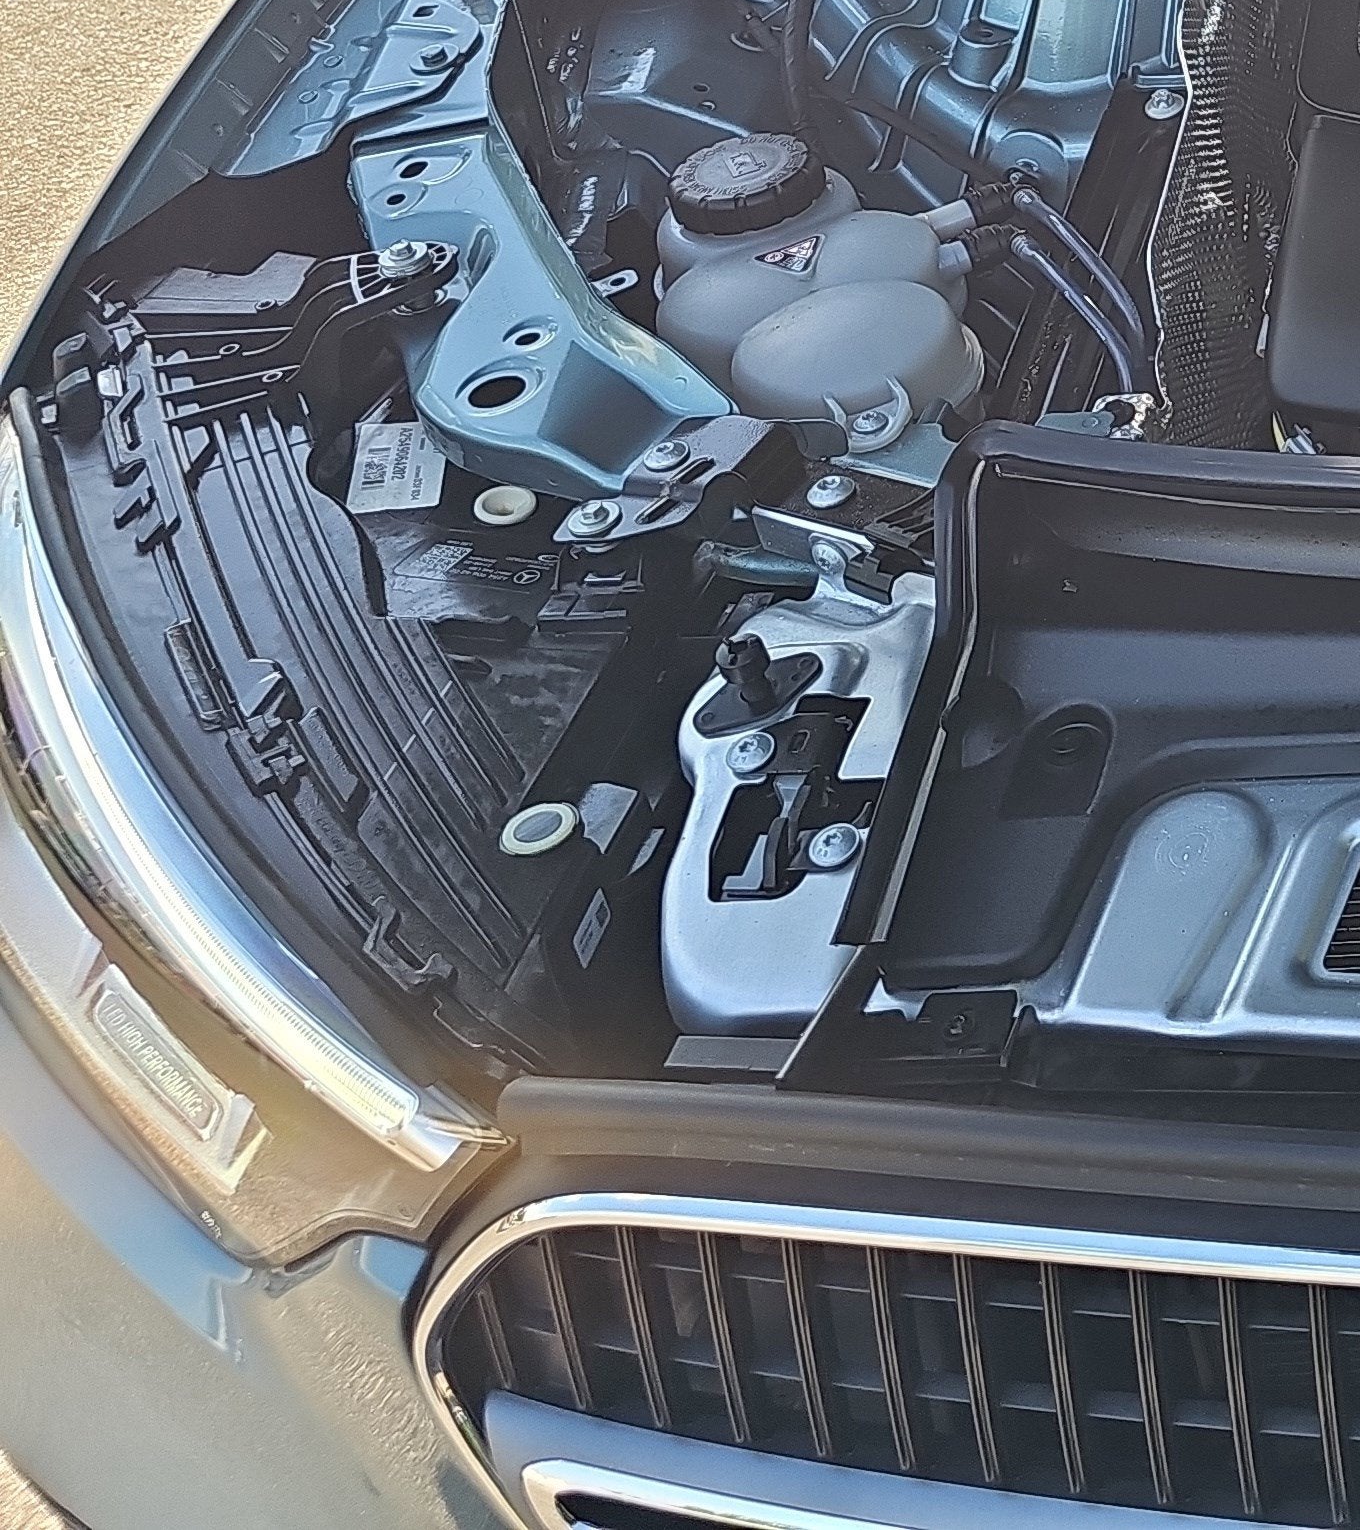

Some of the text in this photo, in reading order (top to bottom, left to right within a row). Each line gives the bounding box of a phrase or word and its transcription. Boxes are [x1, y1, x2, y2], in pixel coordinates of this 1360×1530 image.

[390, 427, 414, 481] A2549064202
[101, 1002, 205, 1118] LED HIGH PERFORMANCE
